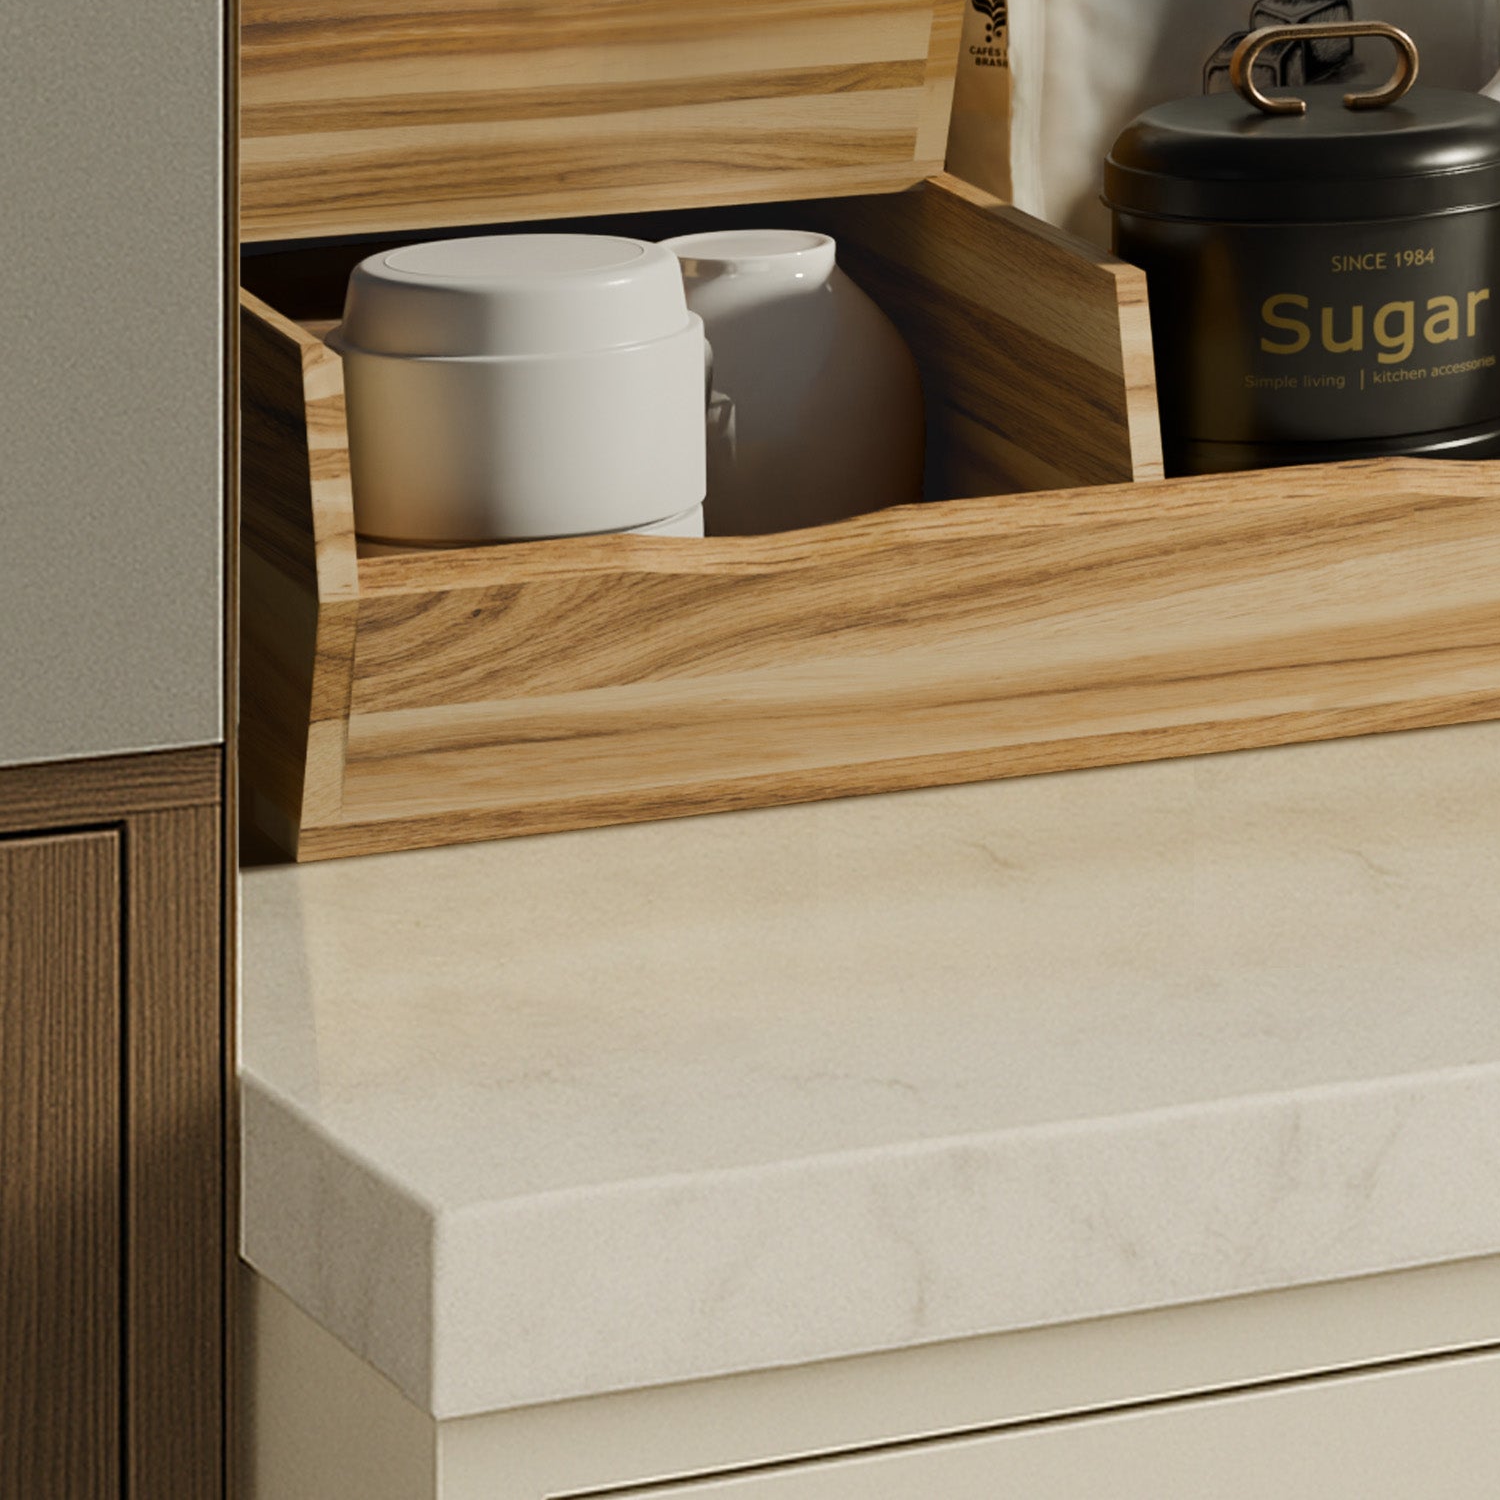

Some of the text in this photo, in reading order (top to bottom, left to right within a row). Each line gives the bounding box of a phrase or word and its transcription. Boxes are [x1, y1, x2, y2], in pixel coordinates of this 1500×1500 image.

[1331, 247, 1436, 273] SINCE 1984
[1260, 287, 1490, 365] Sugar
[1244, 355, 1497, 390] Simple living kitchen accessories
